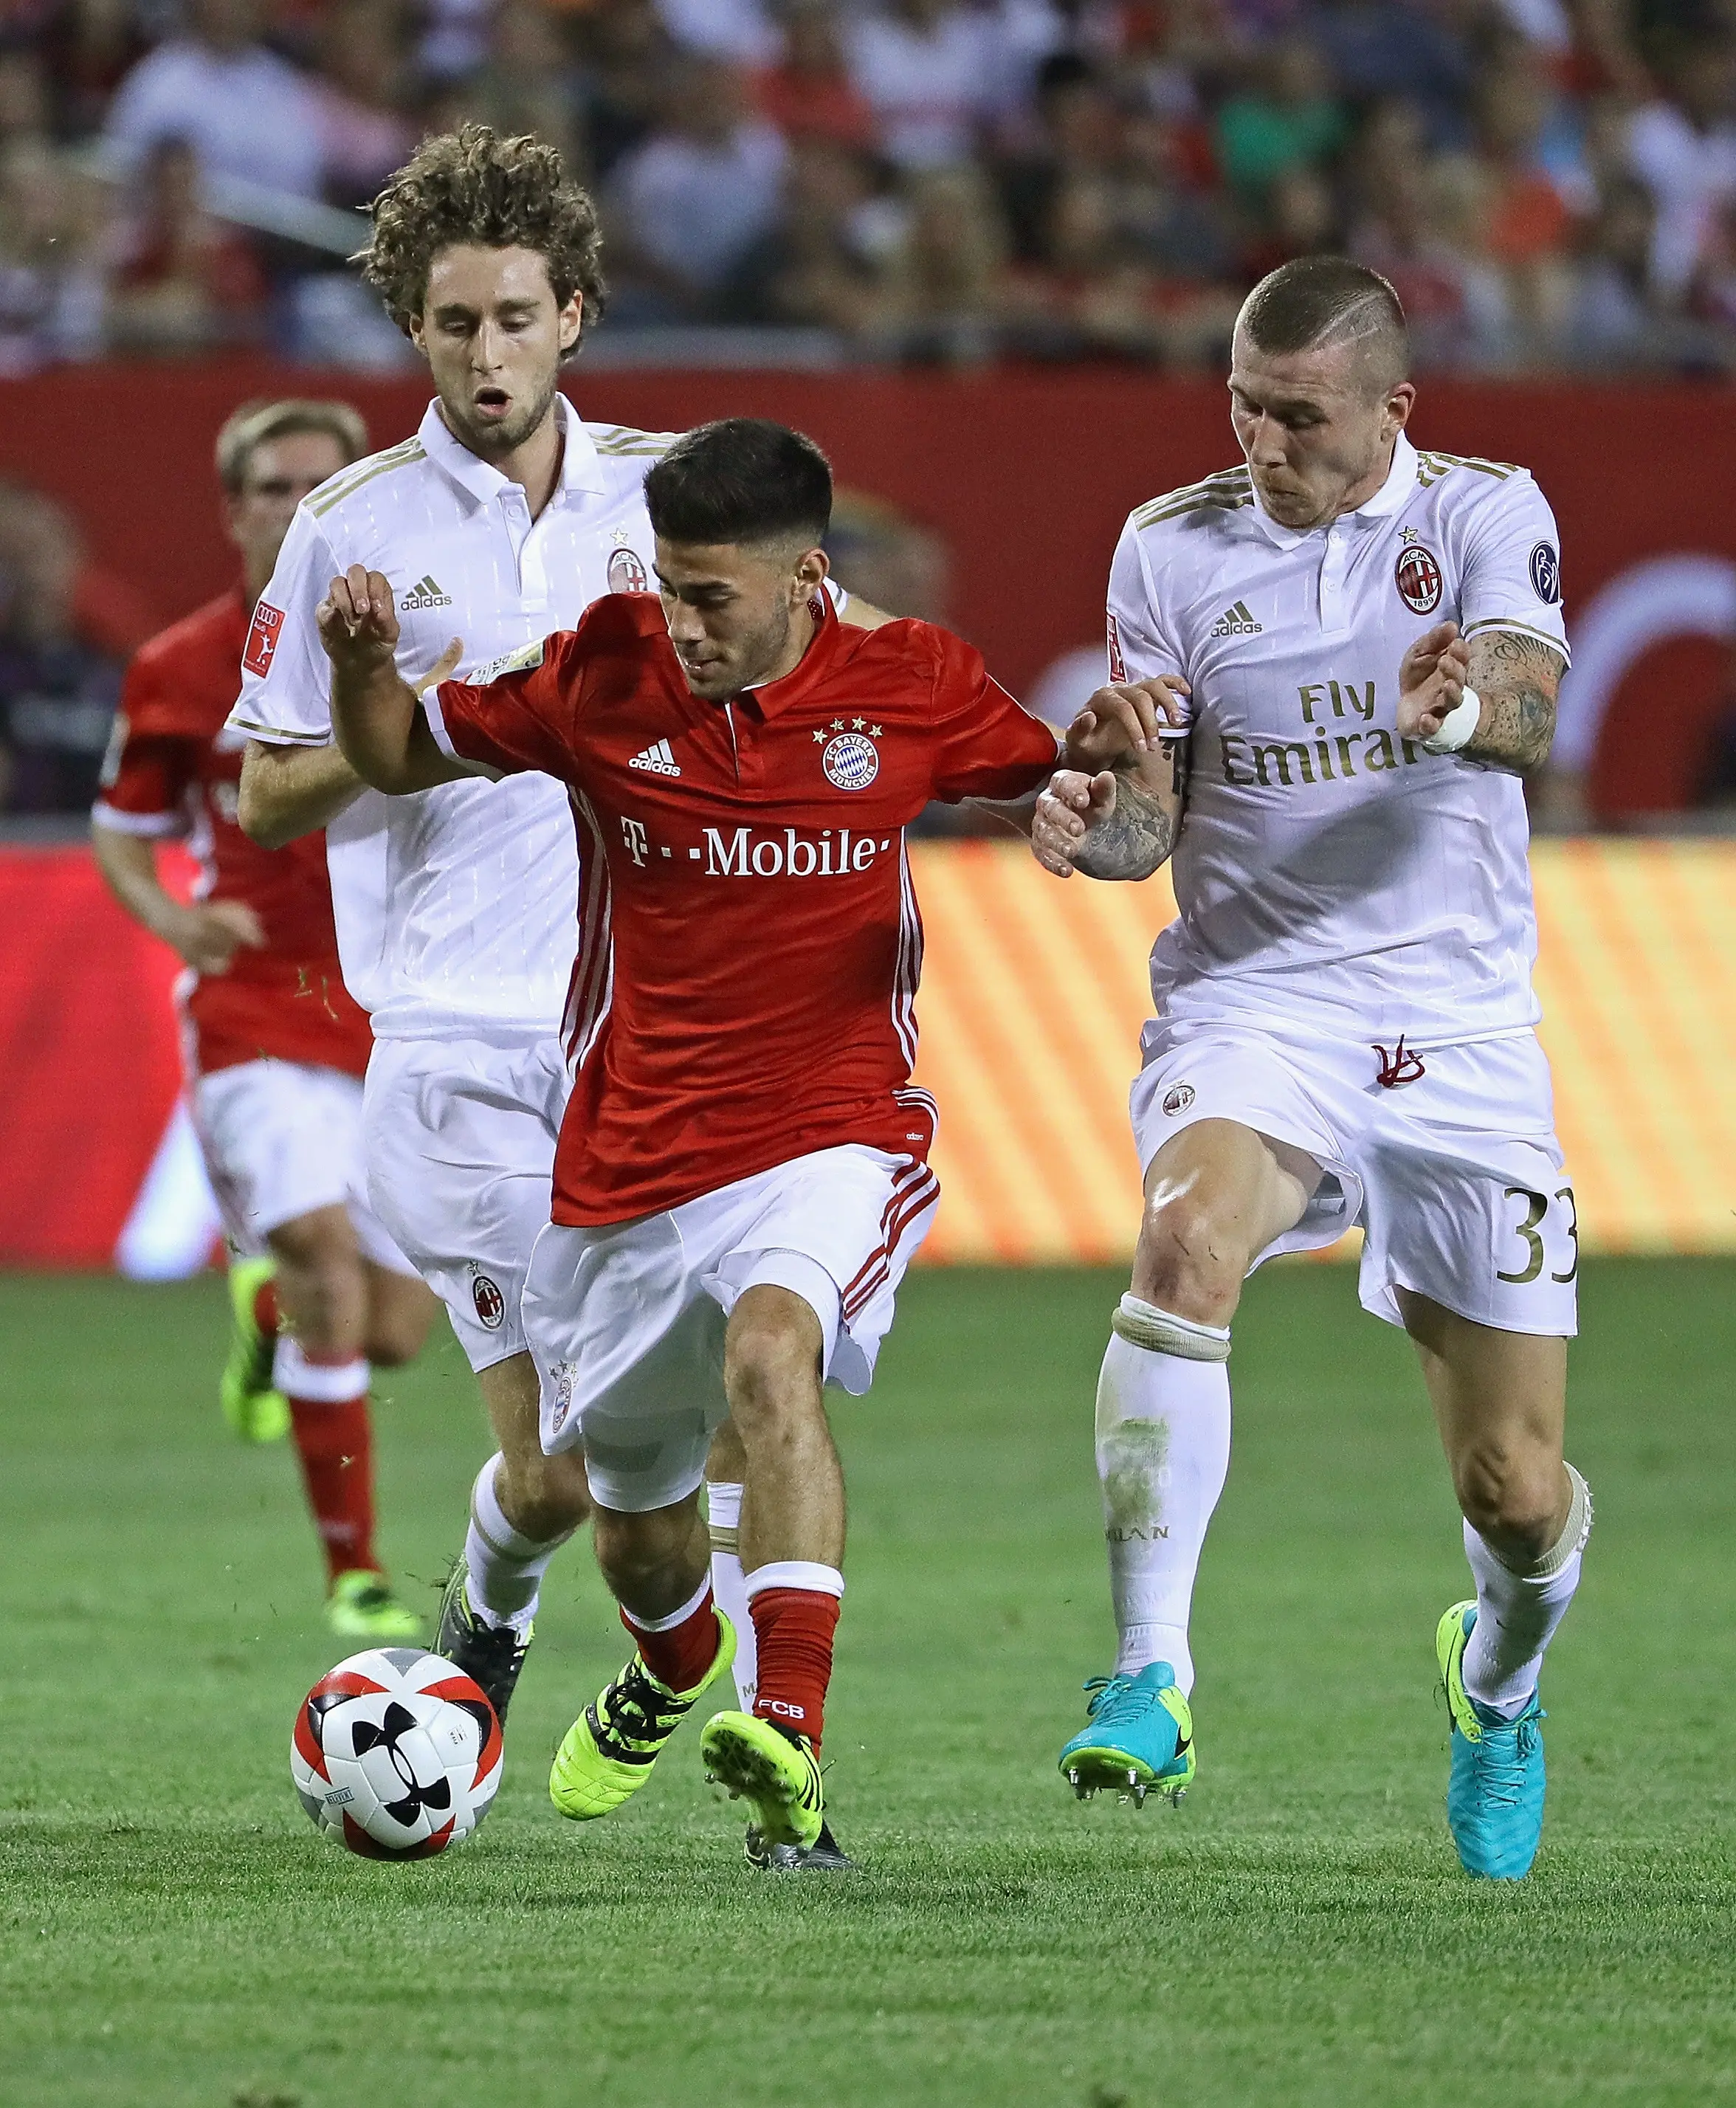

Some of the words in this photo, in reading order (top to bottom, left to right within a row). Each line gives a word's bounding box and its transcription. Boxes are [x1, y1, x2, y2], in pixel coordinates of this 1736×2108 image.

[1403, 551, 1427, 565] ACM
[401, 595, 452, 611] adidas
[1413, 596, 1434, 607] 1899
[1210, 621, 1263, 638] adidas
[1297, 679, 1375, 723] Fly
[835, 736, 874, 757] BAYERN
[1220, 726, 1445, 786] Emirat
[628, 757, 682, 777] adidas
[1496, 1187, 1578, 1284] 33
[759, 1699, 805, 1719] FCB
